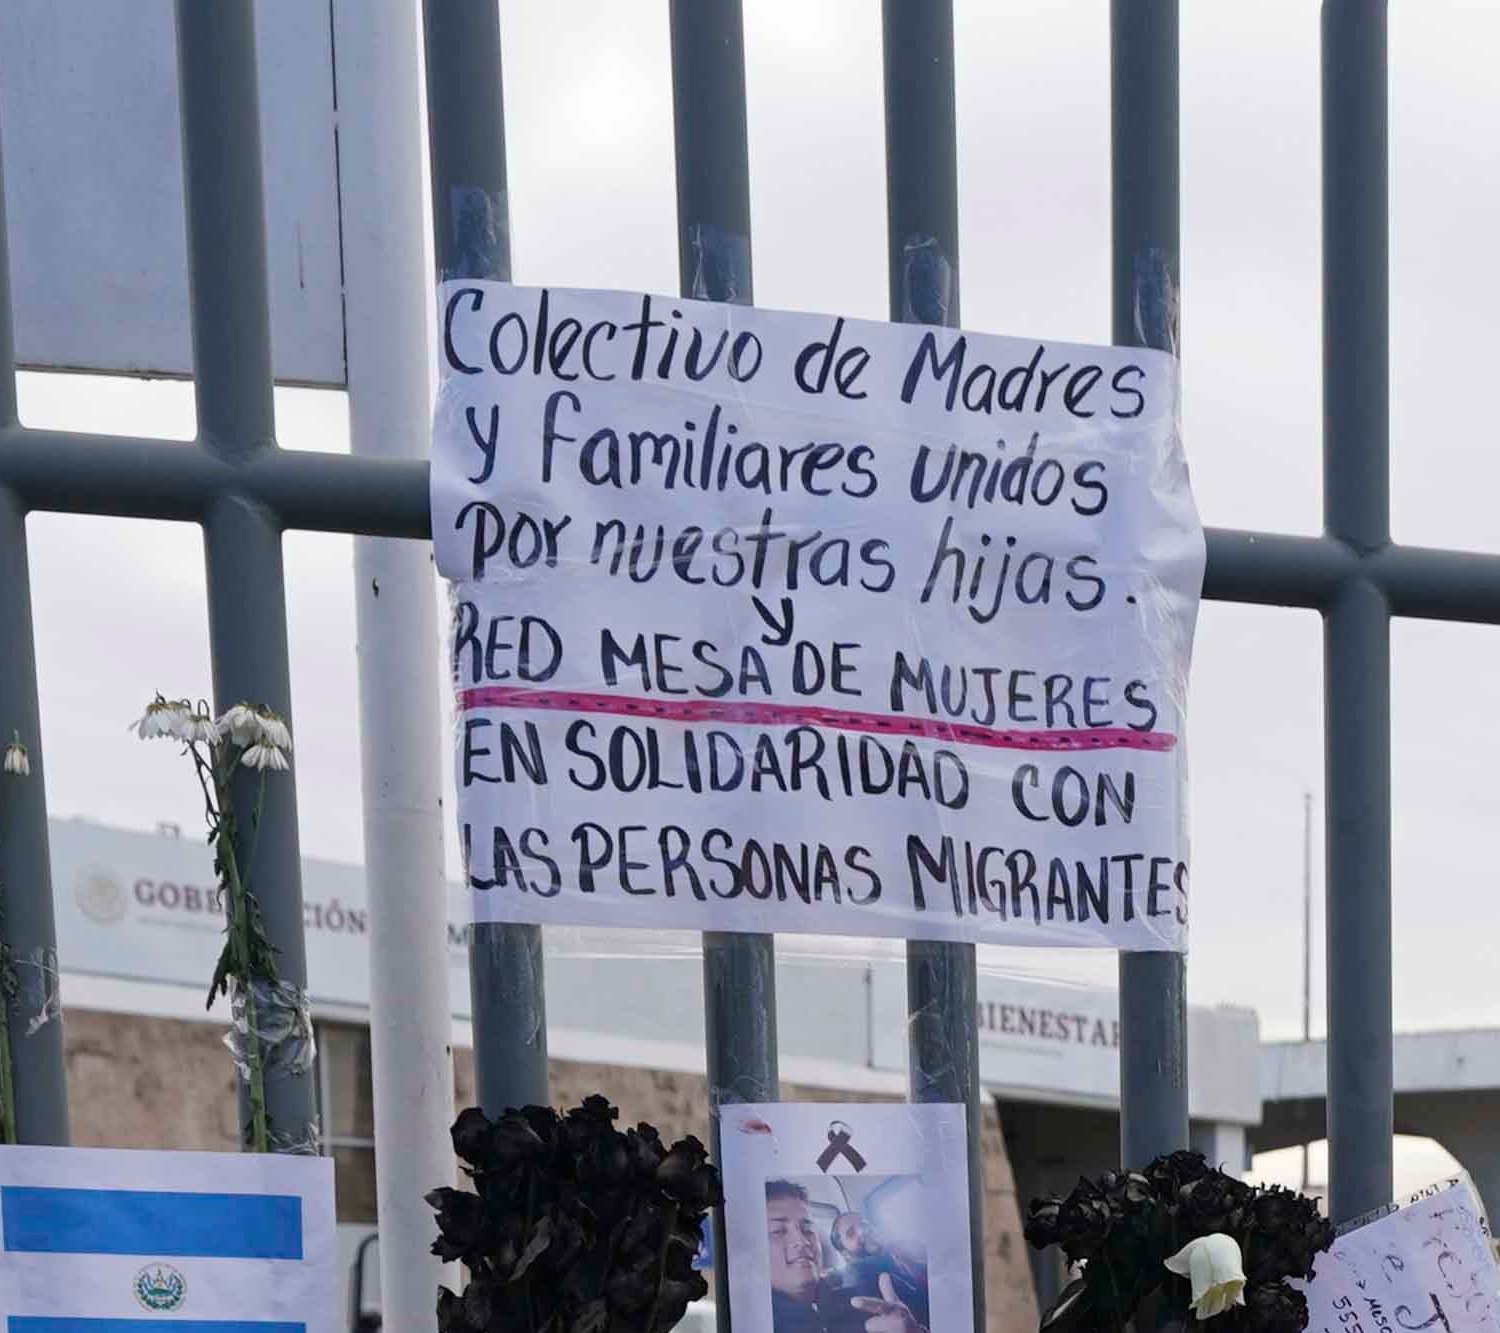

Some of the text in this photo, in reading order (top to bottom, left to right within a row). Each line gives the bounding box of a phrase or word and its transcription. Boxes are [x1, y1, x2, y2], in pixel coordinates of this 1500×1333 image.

[444, 287, 1146, 419] Colectivo de Madres
[590, 508, 897, 594] nuestras
[453, 601, 1159, 732] RED MESA DE MUJERES
[462, 717, 1137, 827] EN SOLIDARIDAD CON
[462, 821, 1190, 927] LAS PERSONAS MIGRANTES
